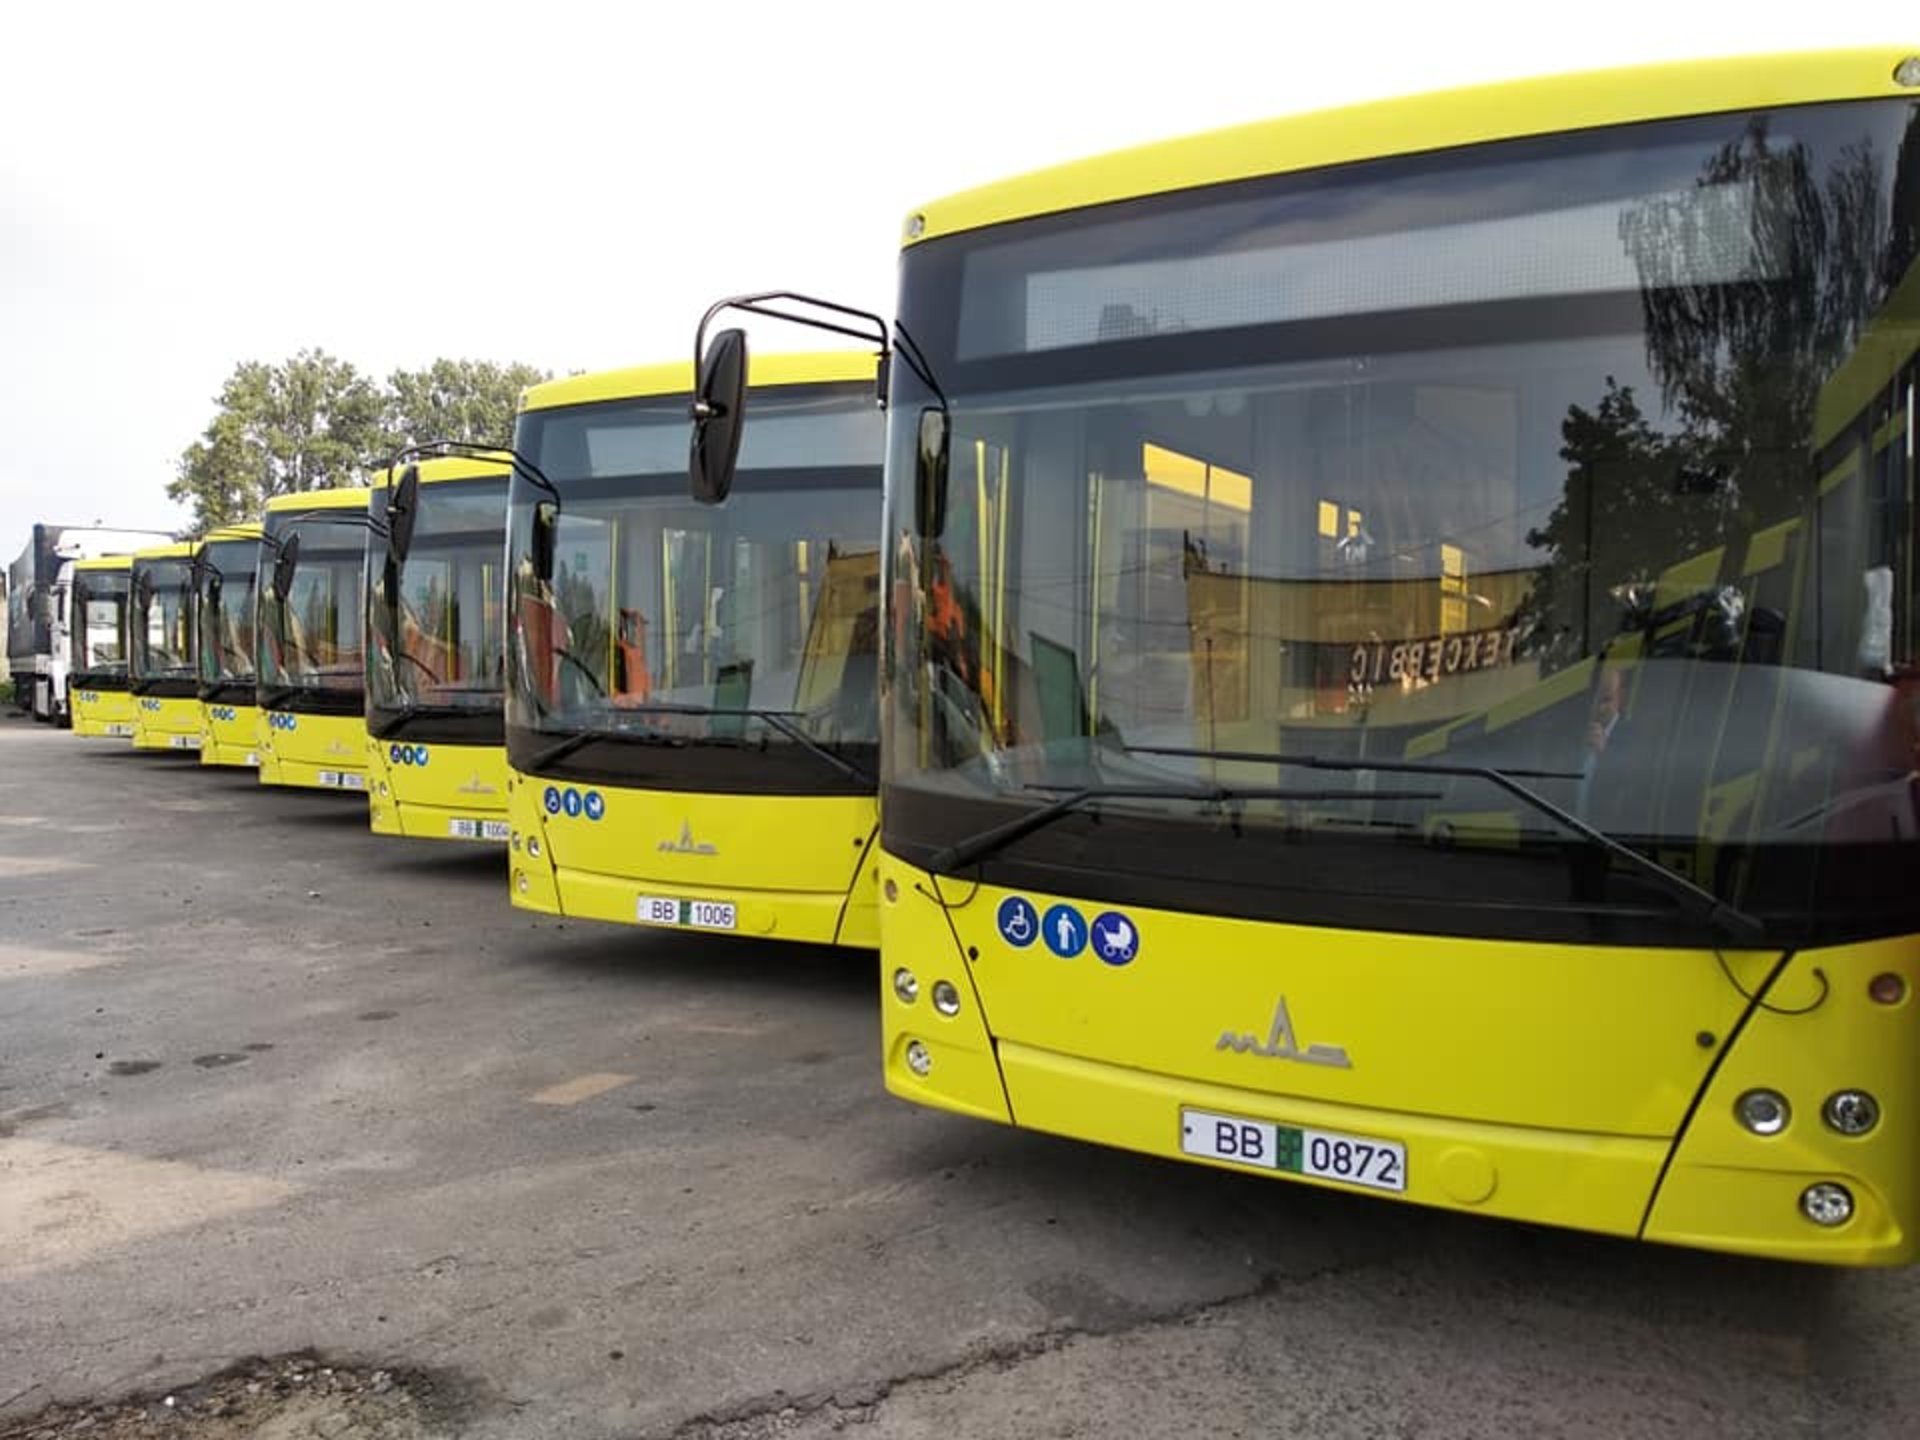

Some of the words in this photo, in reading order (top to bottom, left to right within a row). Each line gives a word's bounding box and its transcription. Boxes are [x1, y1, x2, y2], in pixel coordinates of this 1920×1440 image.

[652, 901, 674, 920] BB
[696, 904, 733, 925] 1006
[1215, 1121, 1263, 1159] BB
[1311, 1137, 1398, 1184] 0872
